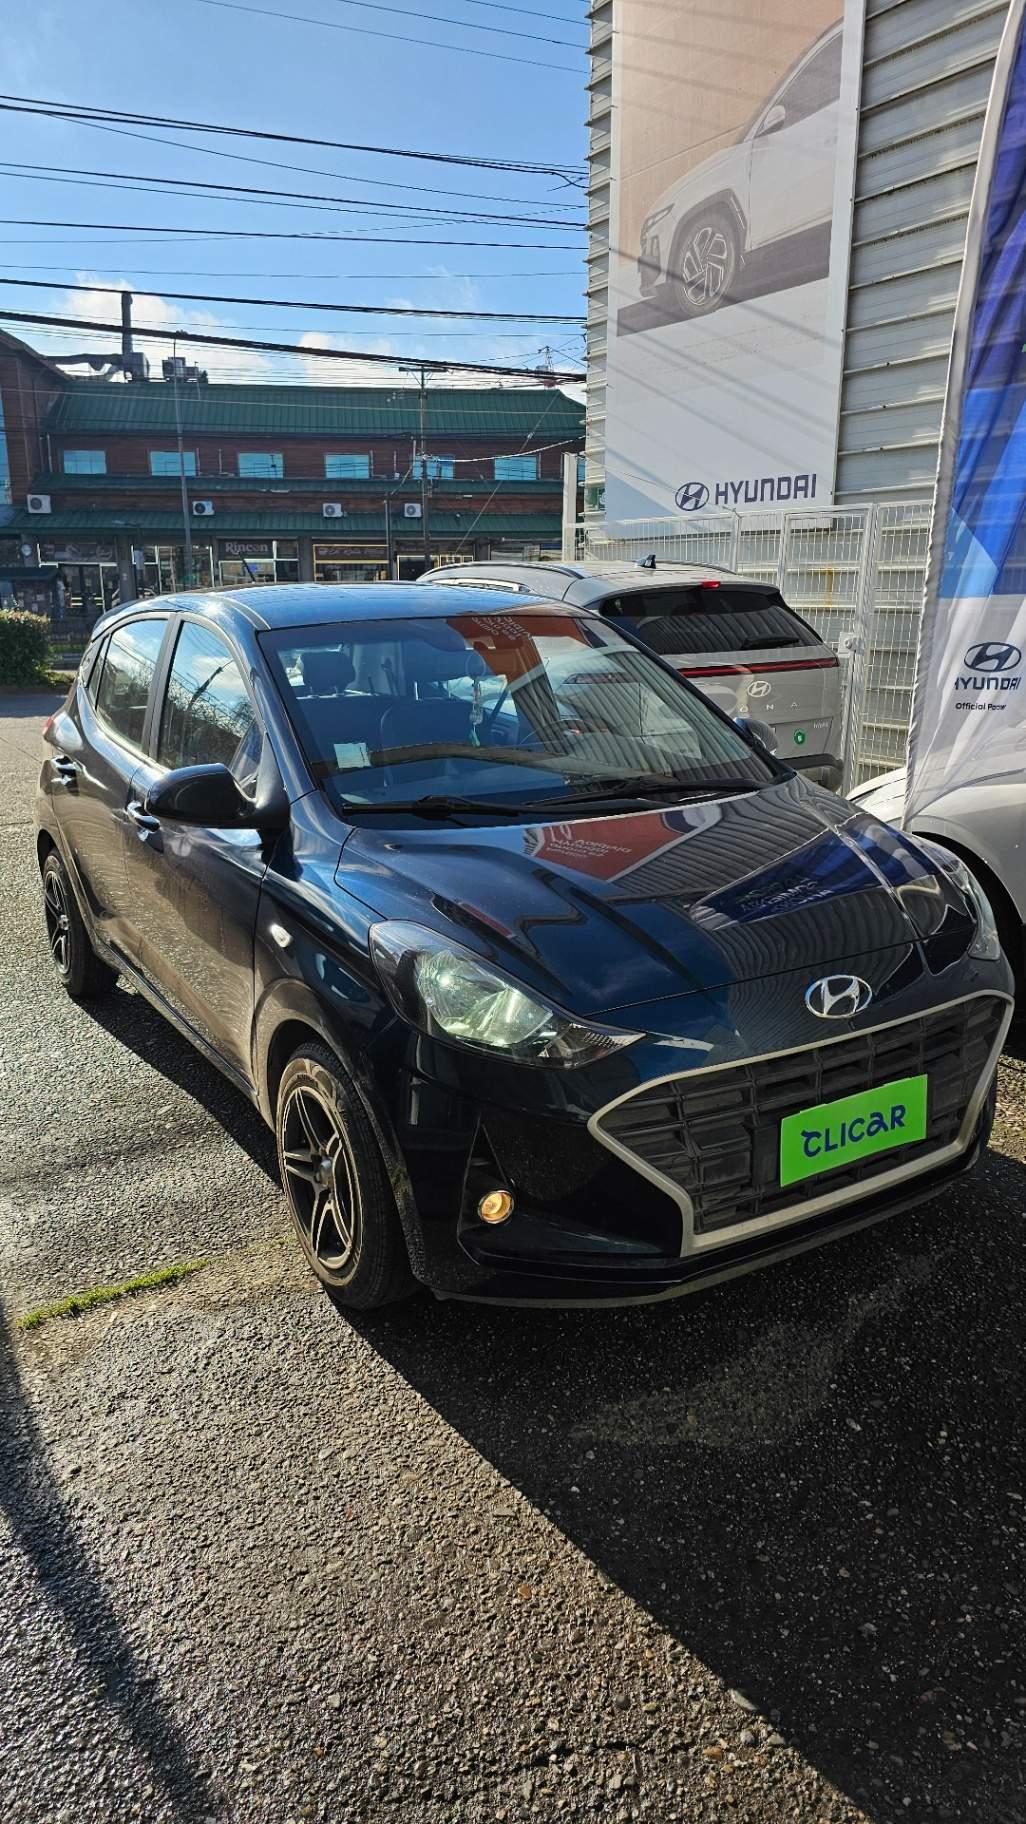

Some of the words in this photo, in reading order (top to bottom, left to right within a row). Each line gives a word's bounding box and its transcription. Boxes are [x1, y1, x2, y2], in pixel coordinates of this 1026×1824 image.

[715, 474, 817, 505] HYUNDAI
[739, 702, 798, 713] ONA
[955, 702, 986, 711] Official
